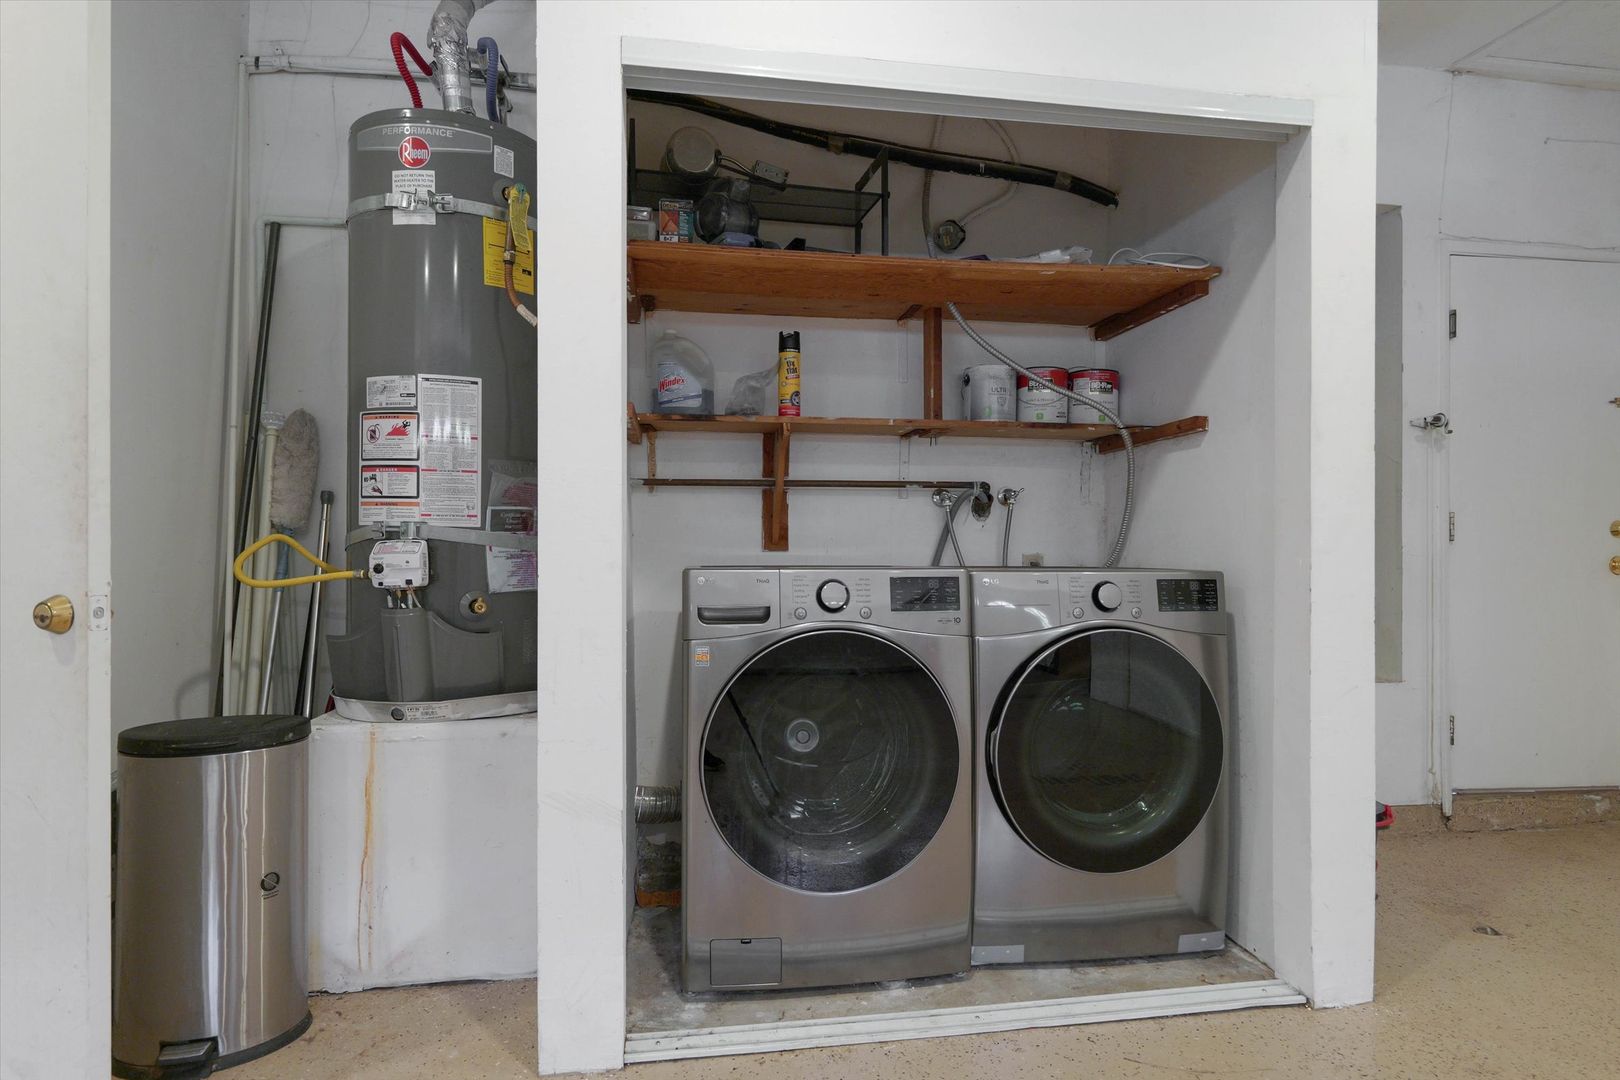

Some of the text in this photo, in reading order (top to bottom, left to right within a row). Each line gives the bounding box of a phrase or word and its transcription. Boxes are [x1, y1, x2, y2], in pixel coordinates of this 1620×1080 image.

[382, 126, 453, 138] PERFORMANCE
[402, 138, 428, 163] Rheem
[658, 375, 685, 393] Windex
